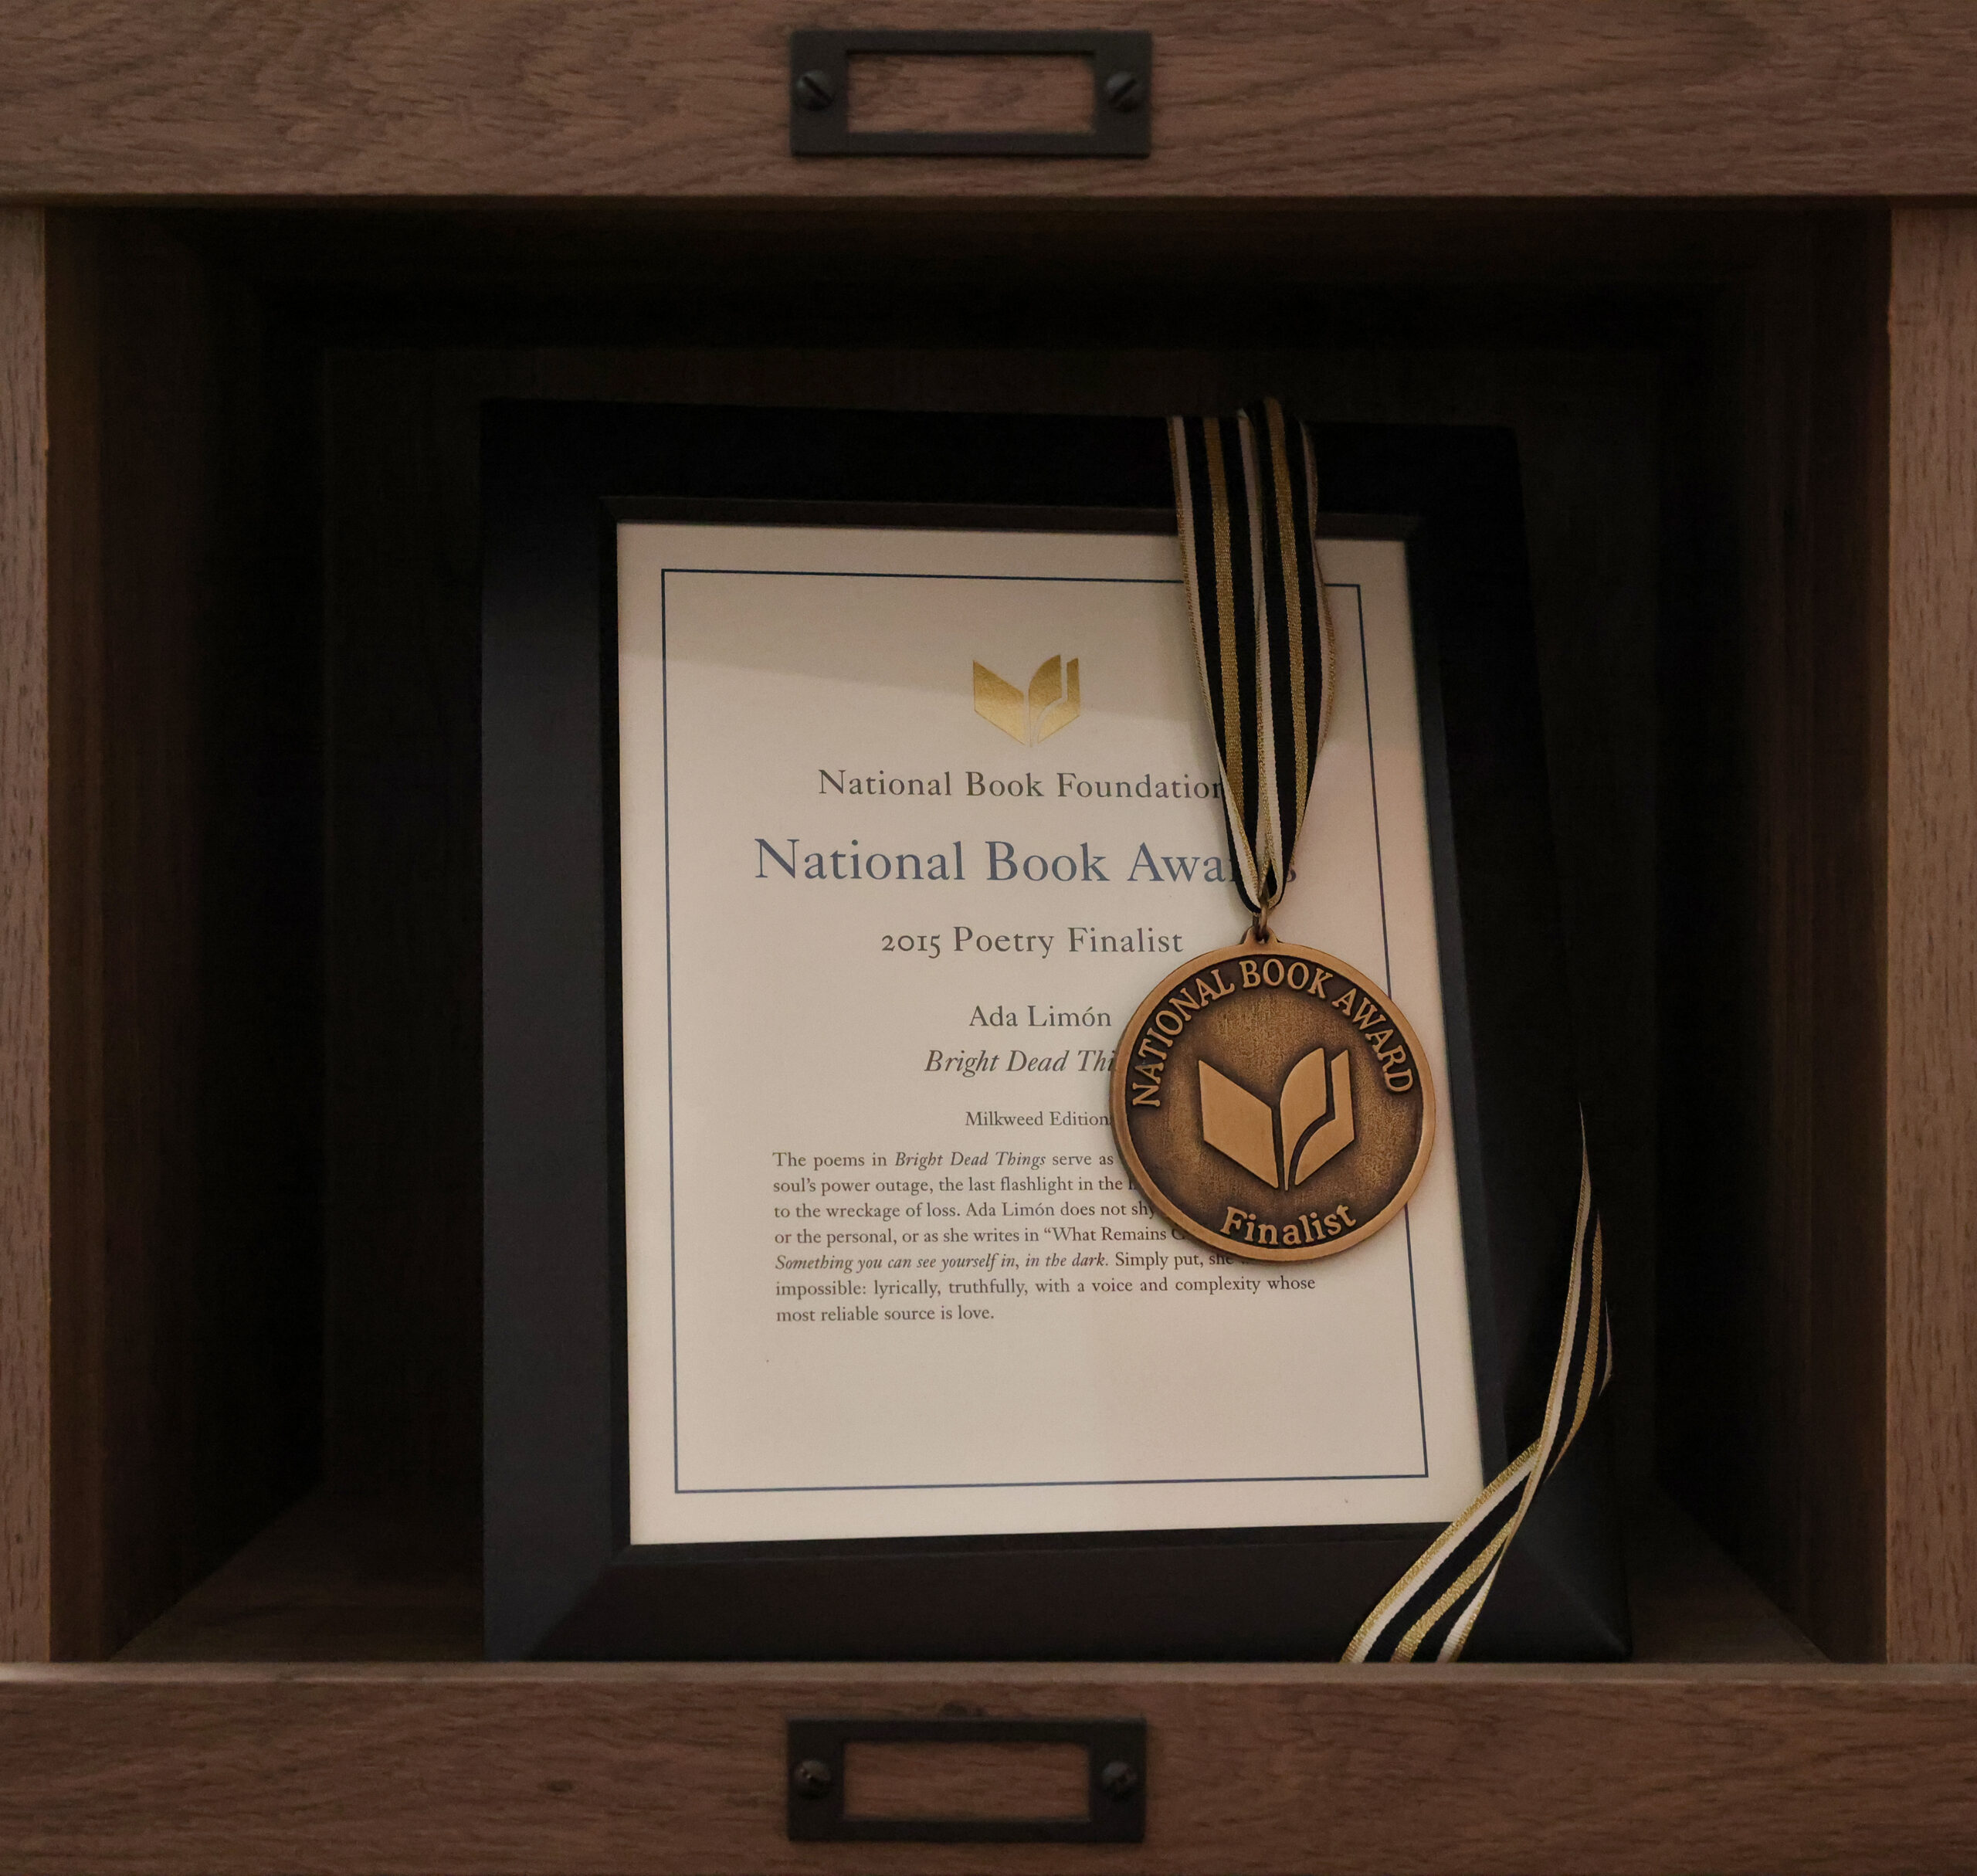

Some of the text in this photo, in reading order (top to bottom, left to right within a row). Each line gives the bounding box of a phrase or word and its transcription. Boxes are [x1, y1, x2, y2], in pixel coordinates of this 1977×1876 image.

[818, 768, 952, 796] National
[965, 771, 1045, 797] Book
[754, 838, 1297, 883] National Book Awa
[881, 926, 1184, 959] 2015 Poetry Finalist
[968, 1005, 1112, 1027] Ada Limón
[1132, 958, 1413, 1107] NATIONAL BOOK AWARD
[924, 1050, 1116, 1078] Bright Dead Thi
[965, 1111, 1111, 1126] Milkweed Edition
[771, 1151, 1114, 1172] The poems in Bright Dead Things serve as
[821, 1182, 871, 1197] power
[875, 1180, 934, 1196] outage,
[938, 1176, 964, 1192] the
[968, 1175, 995, 1192] last
[1000, 1175, 1073, 1196] flashlight
[1078, 1175, 1094, 1191] in
[1097, 1175, 1123, 1191] the
[774, 1207, 791, 1218] to
[795, 1203, 821, 1218] the
[825, 1202, 900, 1223] wreckage
[905, 1202, 924, 1217] of
[926, 1202, 961, 1217] loss.
[965, 1201, 996, 1217] Ada
[1001, 1202, 1055, 1216] Limón
[1060, 1201, 1096, 1216] does
[1100, 1204, 1128, 1216] not
[1220, 1204, 1356, 1246] Finalist
[774, 1233, 792, 1244] or
[796, 1228, 822, 1244] the
[826, 1227, 897, 1248] personal,
[902, 1233, 920, 1243] or
[924, 1232, 939, 1243] as
[943, 1226, 969, 1243] she
[972, 1227, 1020, 1243] writes
[1024, 1227, 1039, 1242] in
[1100, 1226, 1167, 1241] Remains
[775, 1254, 854, 1274] Something
[855, 1258, 883, 1274] you
[887, 1258, 912, 1269] can
[916, 1258, 937, 1268] see
[939, 1252, 1000, 1273] yourself
[1000, 1253, 1019, 1270] in,
[1025, 1253, 1040, 1267] in
[1045, 1252, 1067, 1267] the
[1071, 1251, 1109, 1267] dark.
[1115, 1251, 1169, 1271] Simply
[1174, 1253, 1204, 1270] put,
[776, 1274, 1316, 1301] impossible: lyrically, truthfully, with a voice and complexity whose
[776, 1304, 995, 1322] most reliable source is love.
